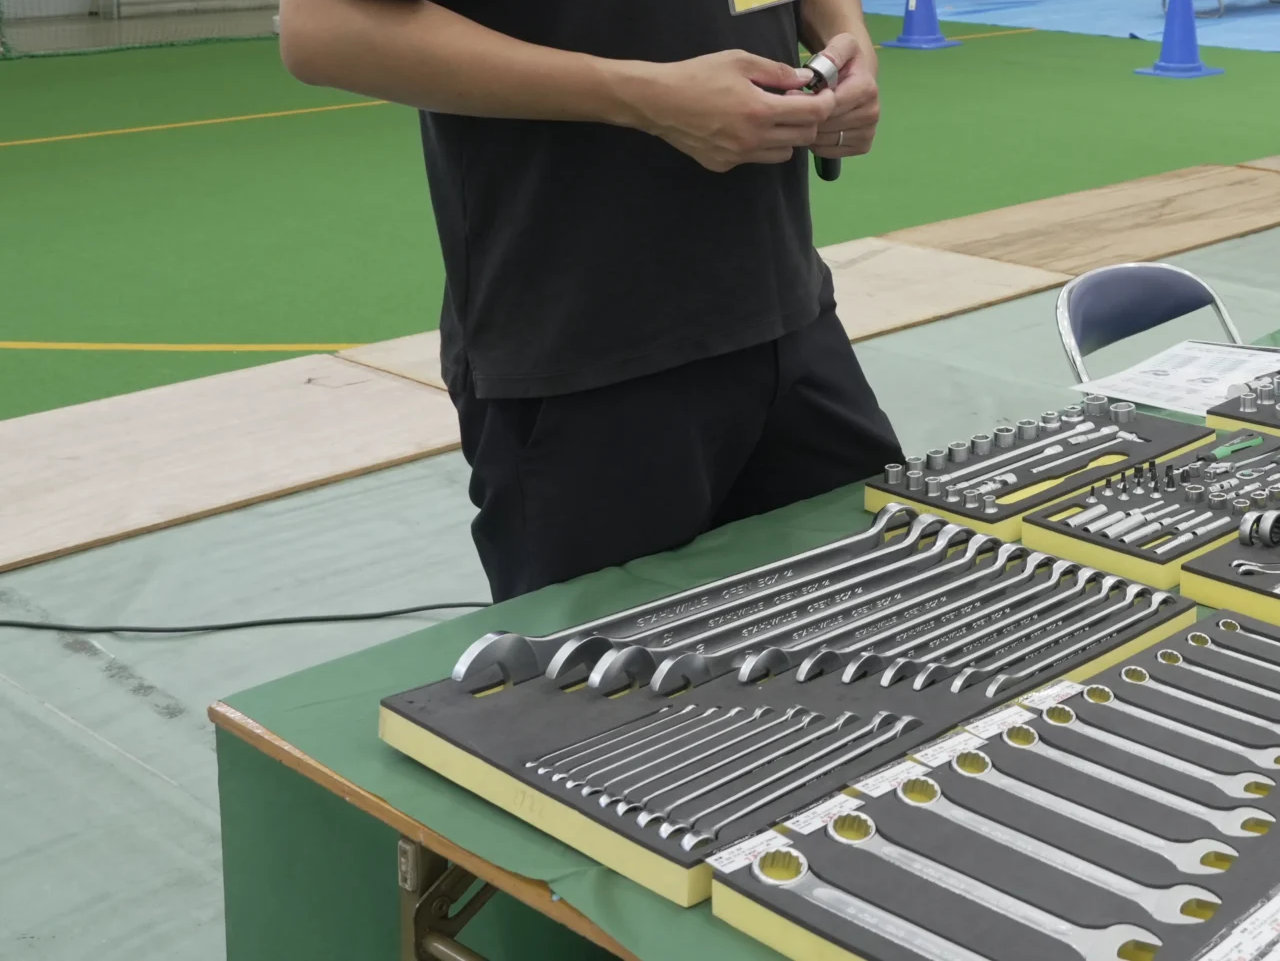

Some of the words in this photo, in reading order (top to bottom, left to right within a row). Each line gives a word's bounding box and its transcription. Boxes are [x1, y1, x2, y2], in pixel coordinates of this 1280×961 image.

[636, 595, 710, 627] STAHLWILLE
[721, 582, 753, 600] OPEN
[757, 573, 779, 588] BOX
[707, 601, 765, 627] STAHLWILLE
[773, 590, 798, 605] OPEN
[801, 582, 819, 595] BOX
[741, 610, 799, 637] STAHLWILLE
[806, 598, 831, 613] OPEN
